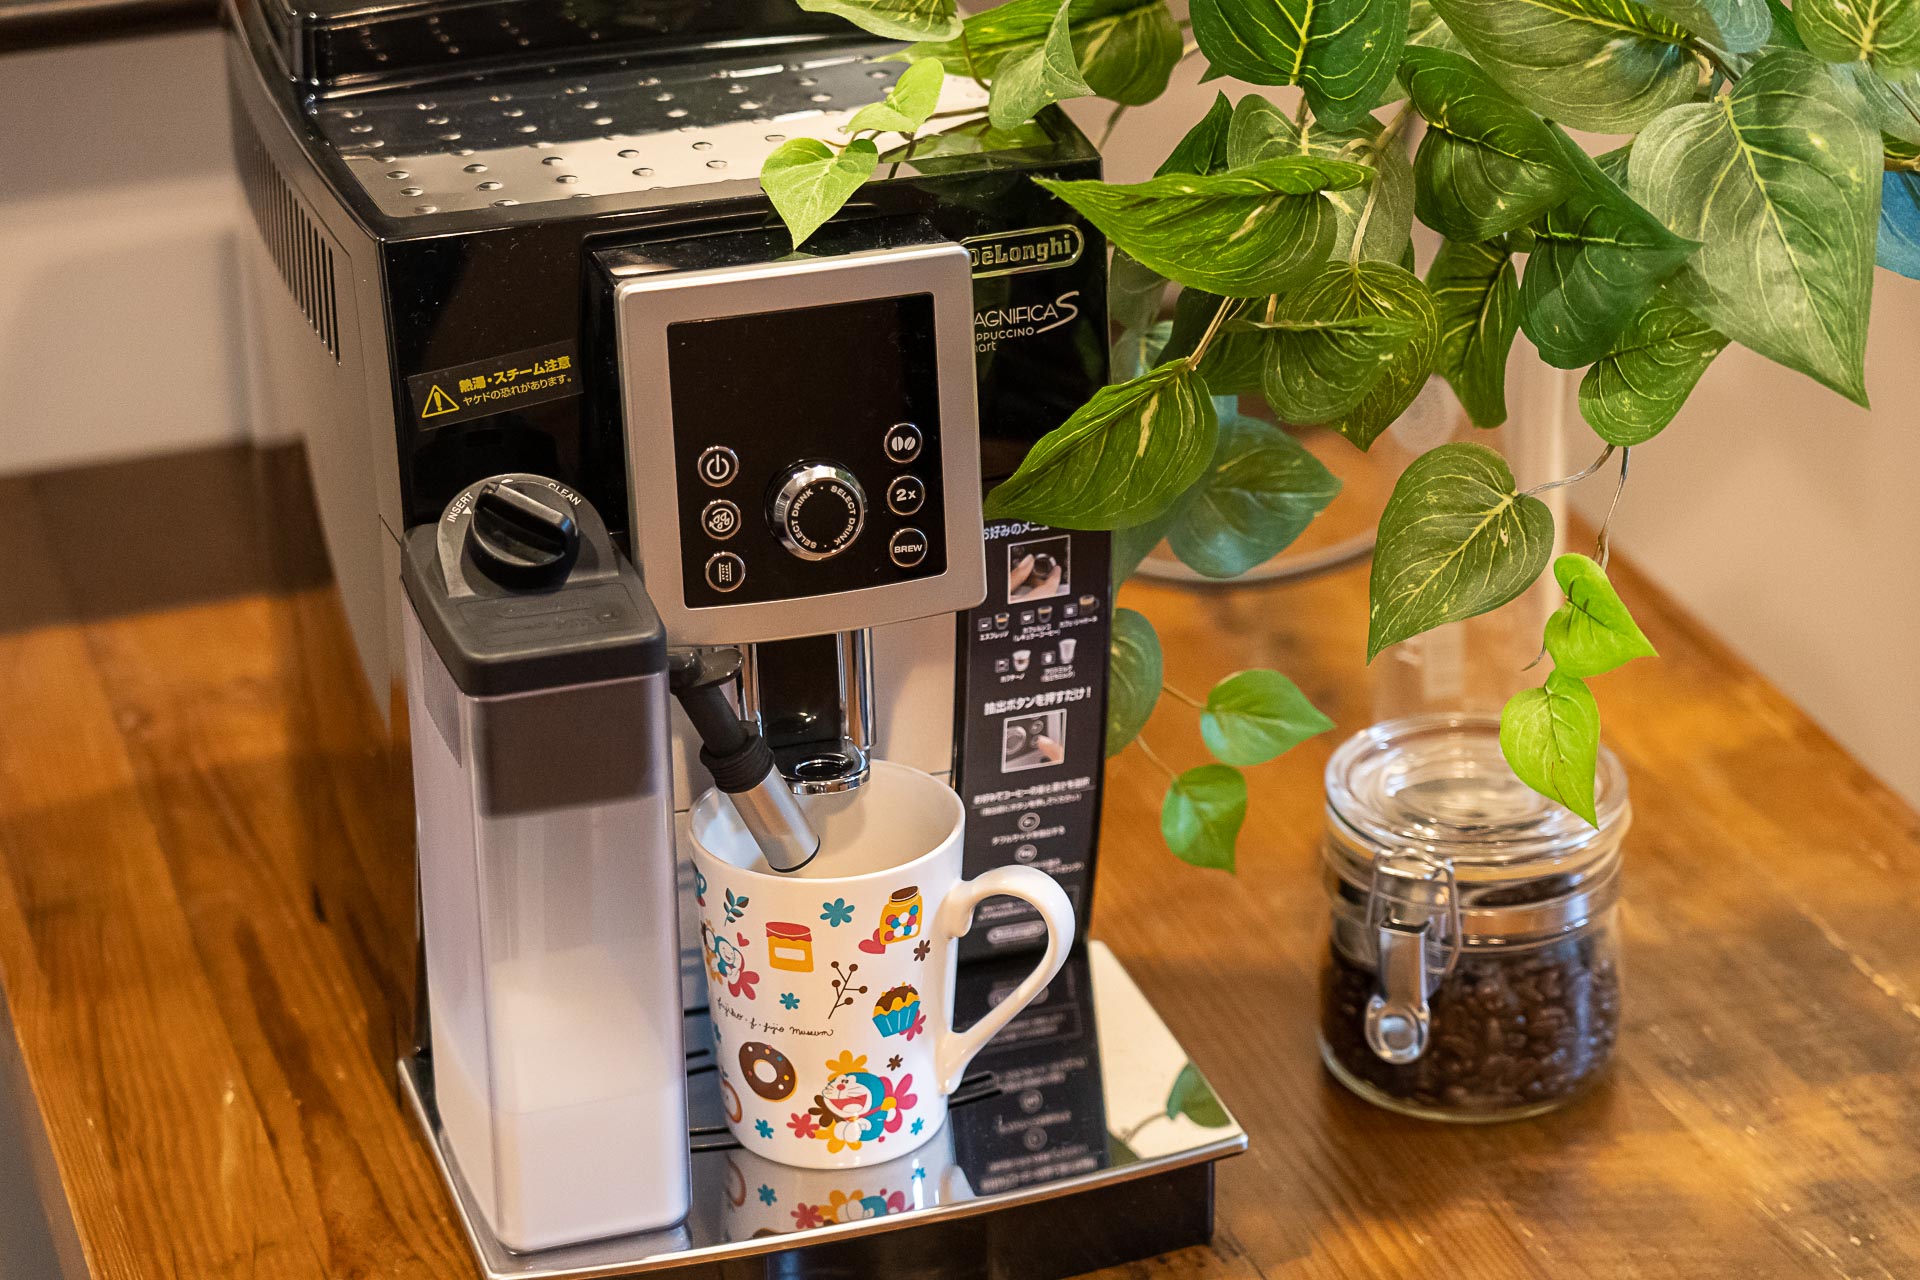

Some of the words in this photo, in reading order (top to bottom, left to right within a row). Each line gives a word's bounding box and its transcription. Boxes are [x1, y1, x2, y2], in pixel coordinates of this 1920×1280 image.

[974, 303, 1059, 328] AGNIFICA
[975, 341, 997, 353] art
[976, 326, 1034, 342] PPUCCINO
[462, 374, 572, 406] ヤケドの恐れがあります。
[446, 491, 474, 523] INSERT
[548, 482, 582, 506] CLEAN
[791, 488, 814, 517] DRINK
[830, 485, 857, 515] SELECT
[791, 519, 817, 549] SELECT
[834, 517, 856, 546] DRINK
[894, 543, 923, 554] BREW
